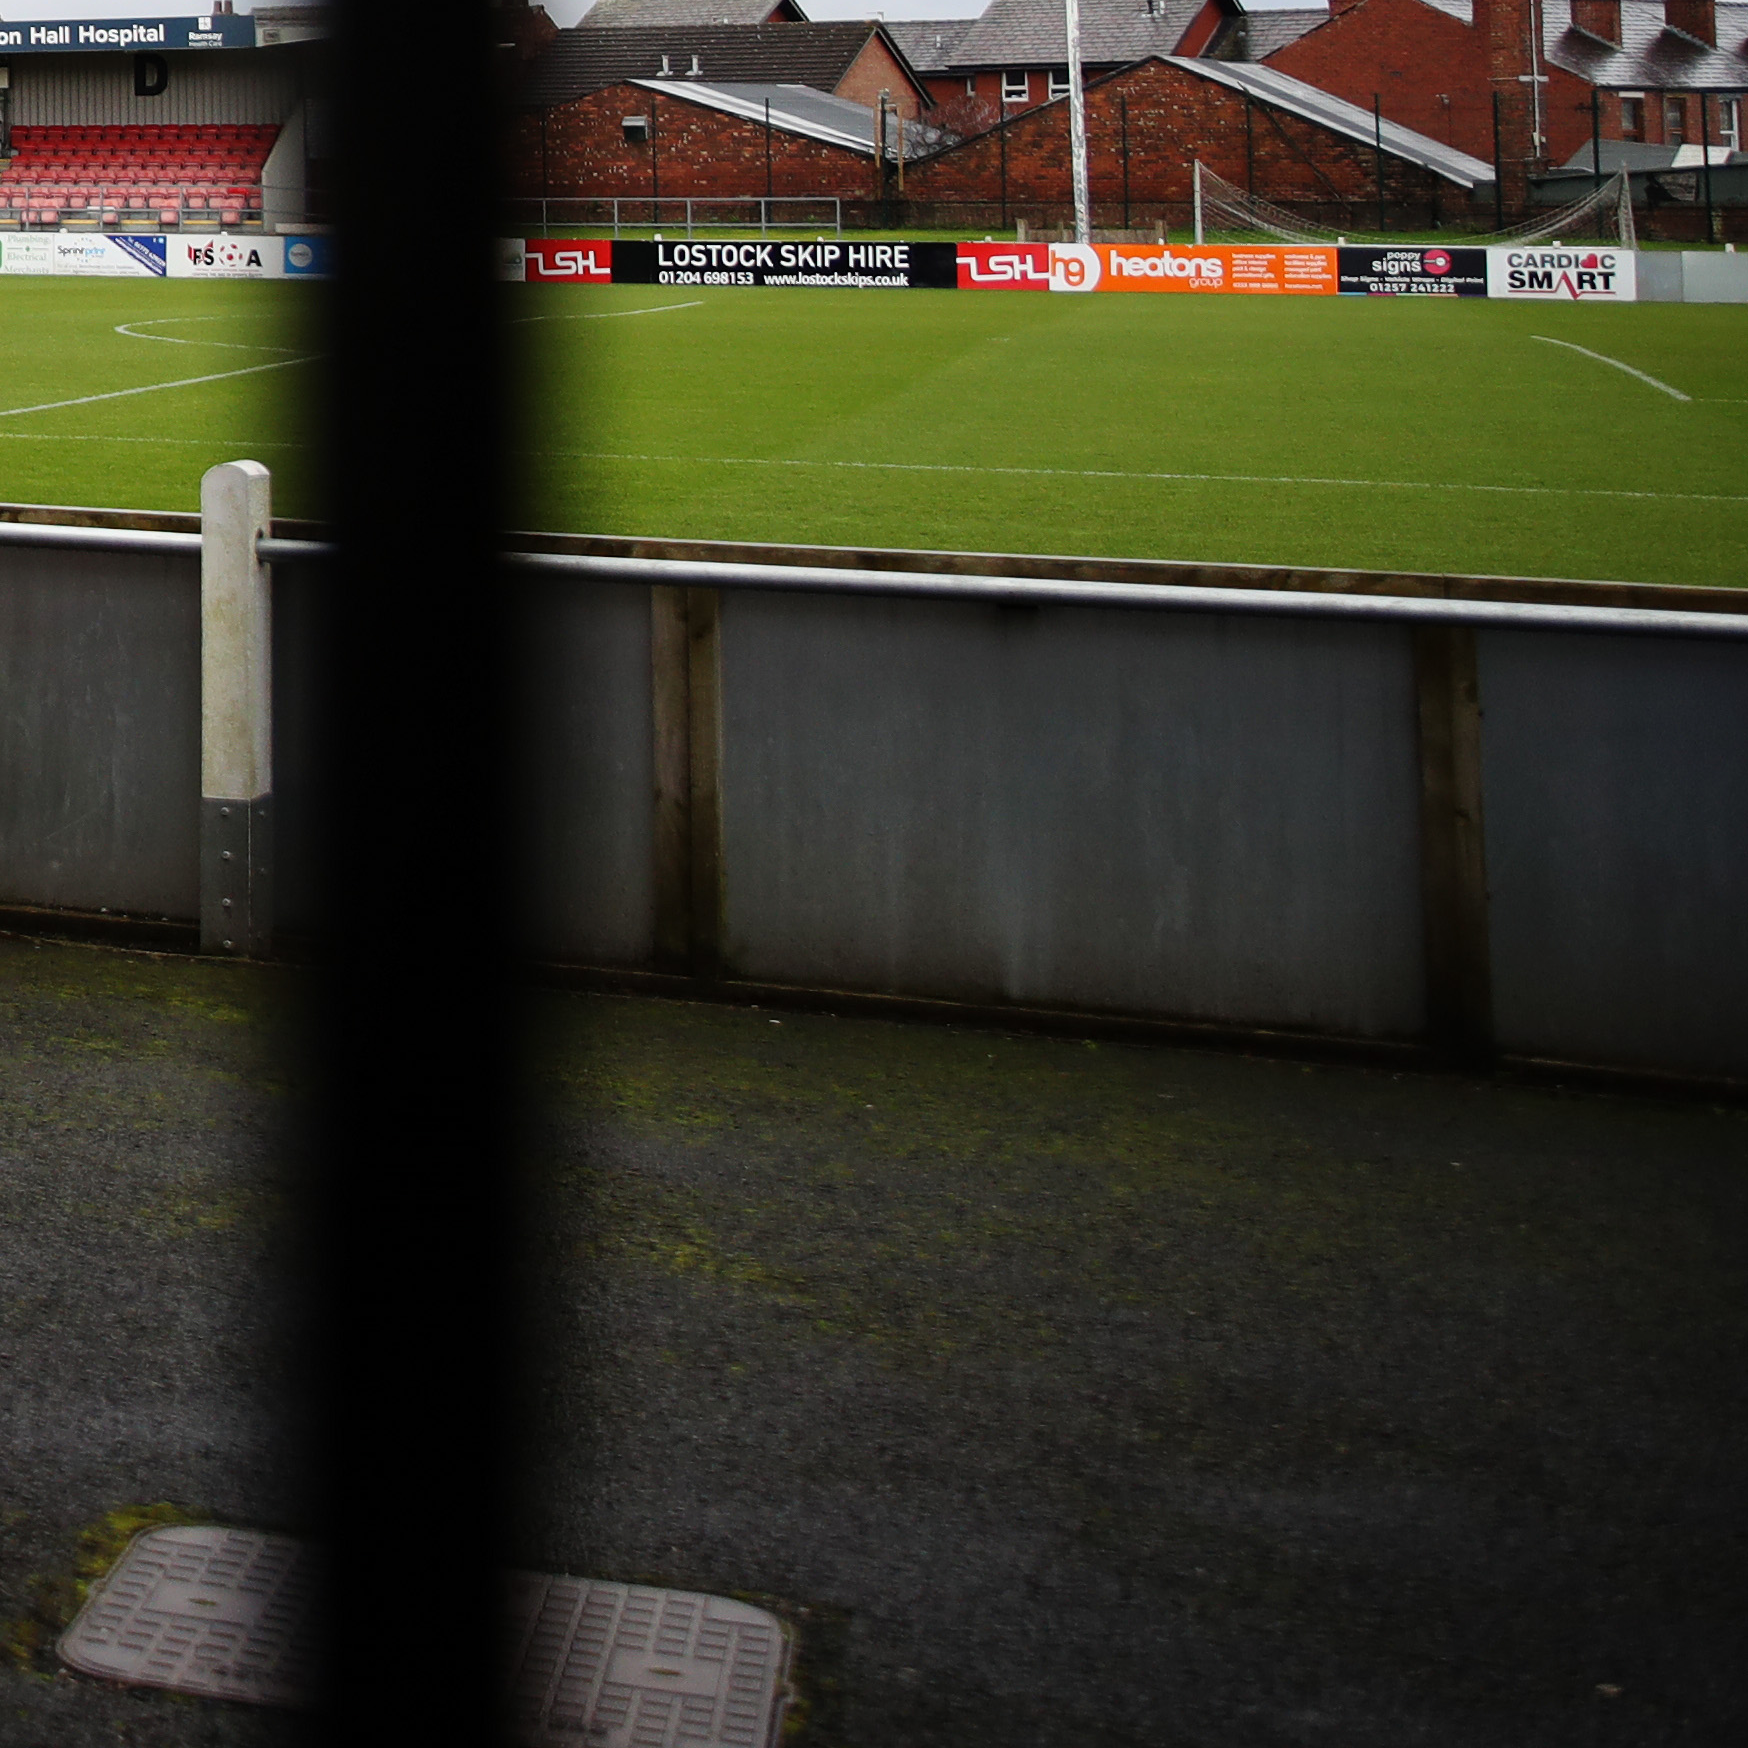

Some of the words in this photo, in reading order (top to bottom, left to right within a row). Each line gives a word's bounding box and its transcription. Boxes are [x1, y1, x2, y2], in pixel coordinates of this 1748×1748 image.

[30, 26, 70, 45] Hall
[79, 24, 165, 48] Hospital
[134, 53, 168, 96] D
[7, 235, 50, 245] Plumbing
[7, 253, 47, 261] Electrical
[658, 244, 773, 267] LOSTOCK
[780, 245, 840, 268] SKIP
[848, 245, 910, 268] HIRE
[1387, 252, 1421, 261] poppy
[5, 265, 49, 274] Merchants
[1110, 250, 1223, 278] heatons
[1372, 258, 1422, 275] signs
[659, 271, 701, 284] 01204
[703, 271, 754, 284] 698153
[763, 272, 910, 288] www.lostockskips.co.uk
[1189, 277, 1223, 288] group
[1370, 283, 1406, 292] 01257
[1410, 284, 1455, 293] 241222
